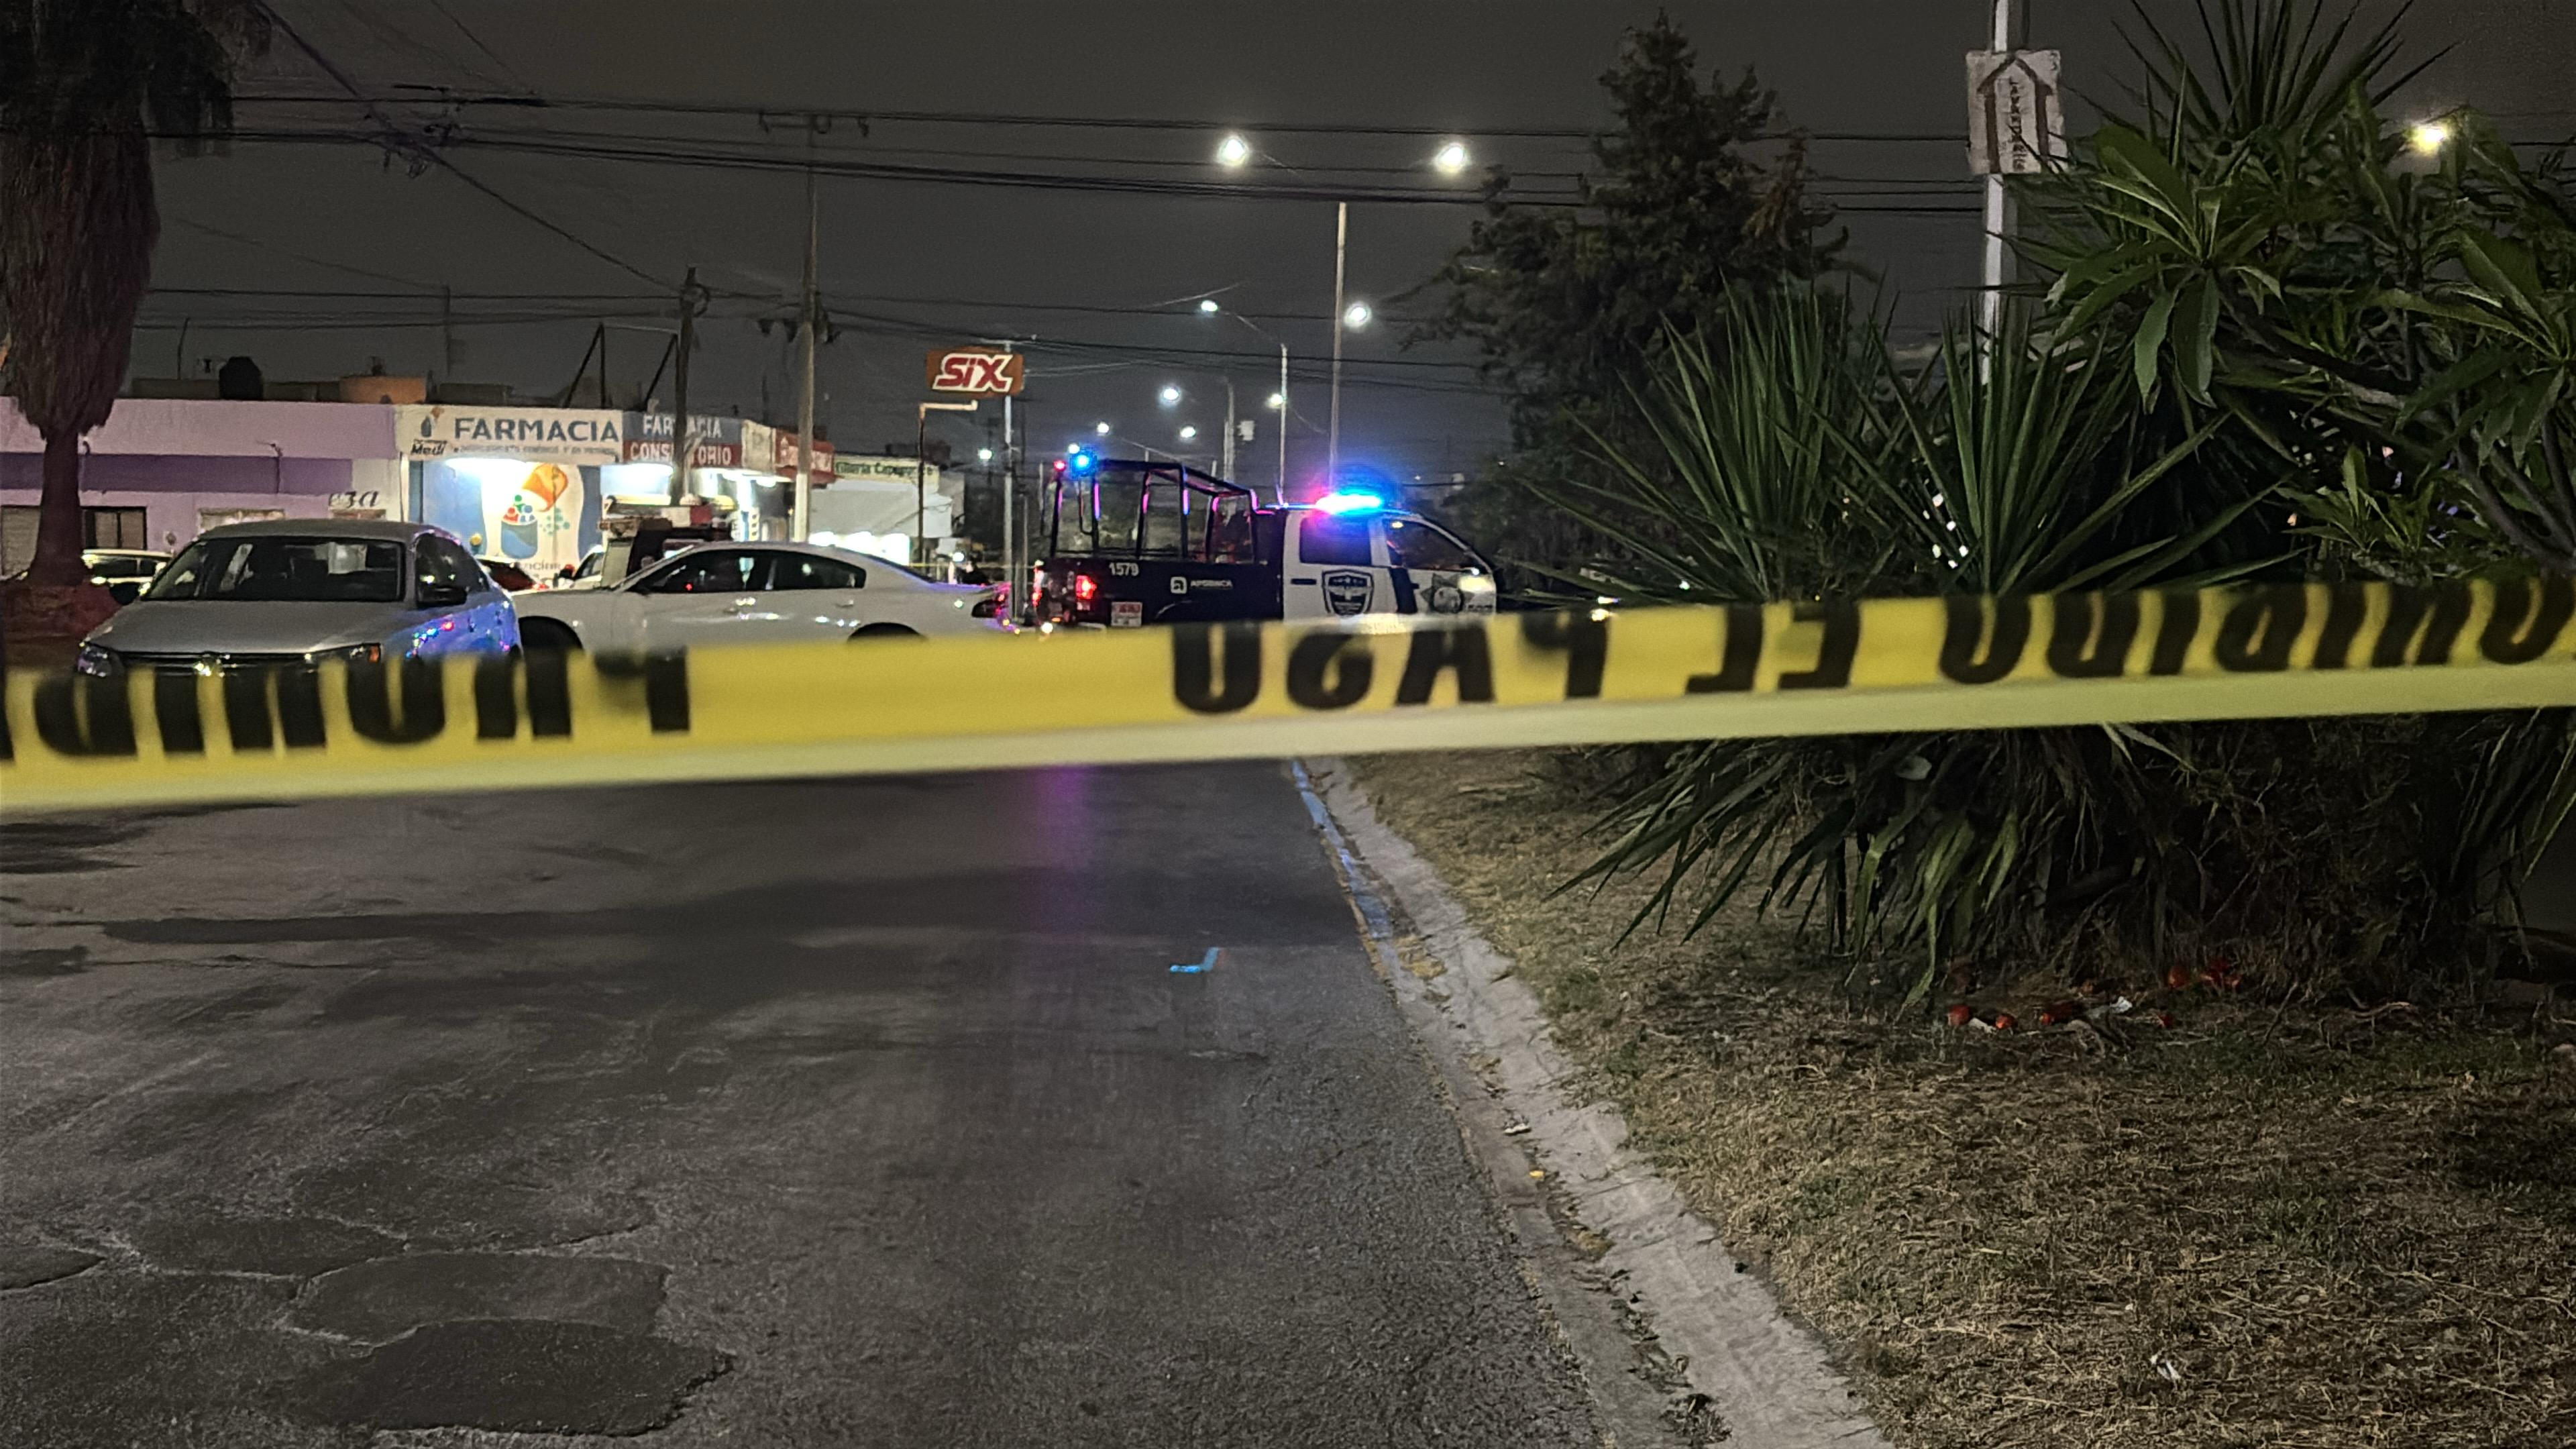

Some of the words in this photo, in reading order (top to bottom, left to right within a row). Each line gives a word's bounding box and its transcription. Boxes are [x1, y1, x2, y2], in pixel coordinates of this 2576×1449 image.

[454, 417, 619, 443] FARMACIA
[643, 414, 722, 438] FARACIA
[1108, 561, 1140, 577] 1579
